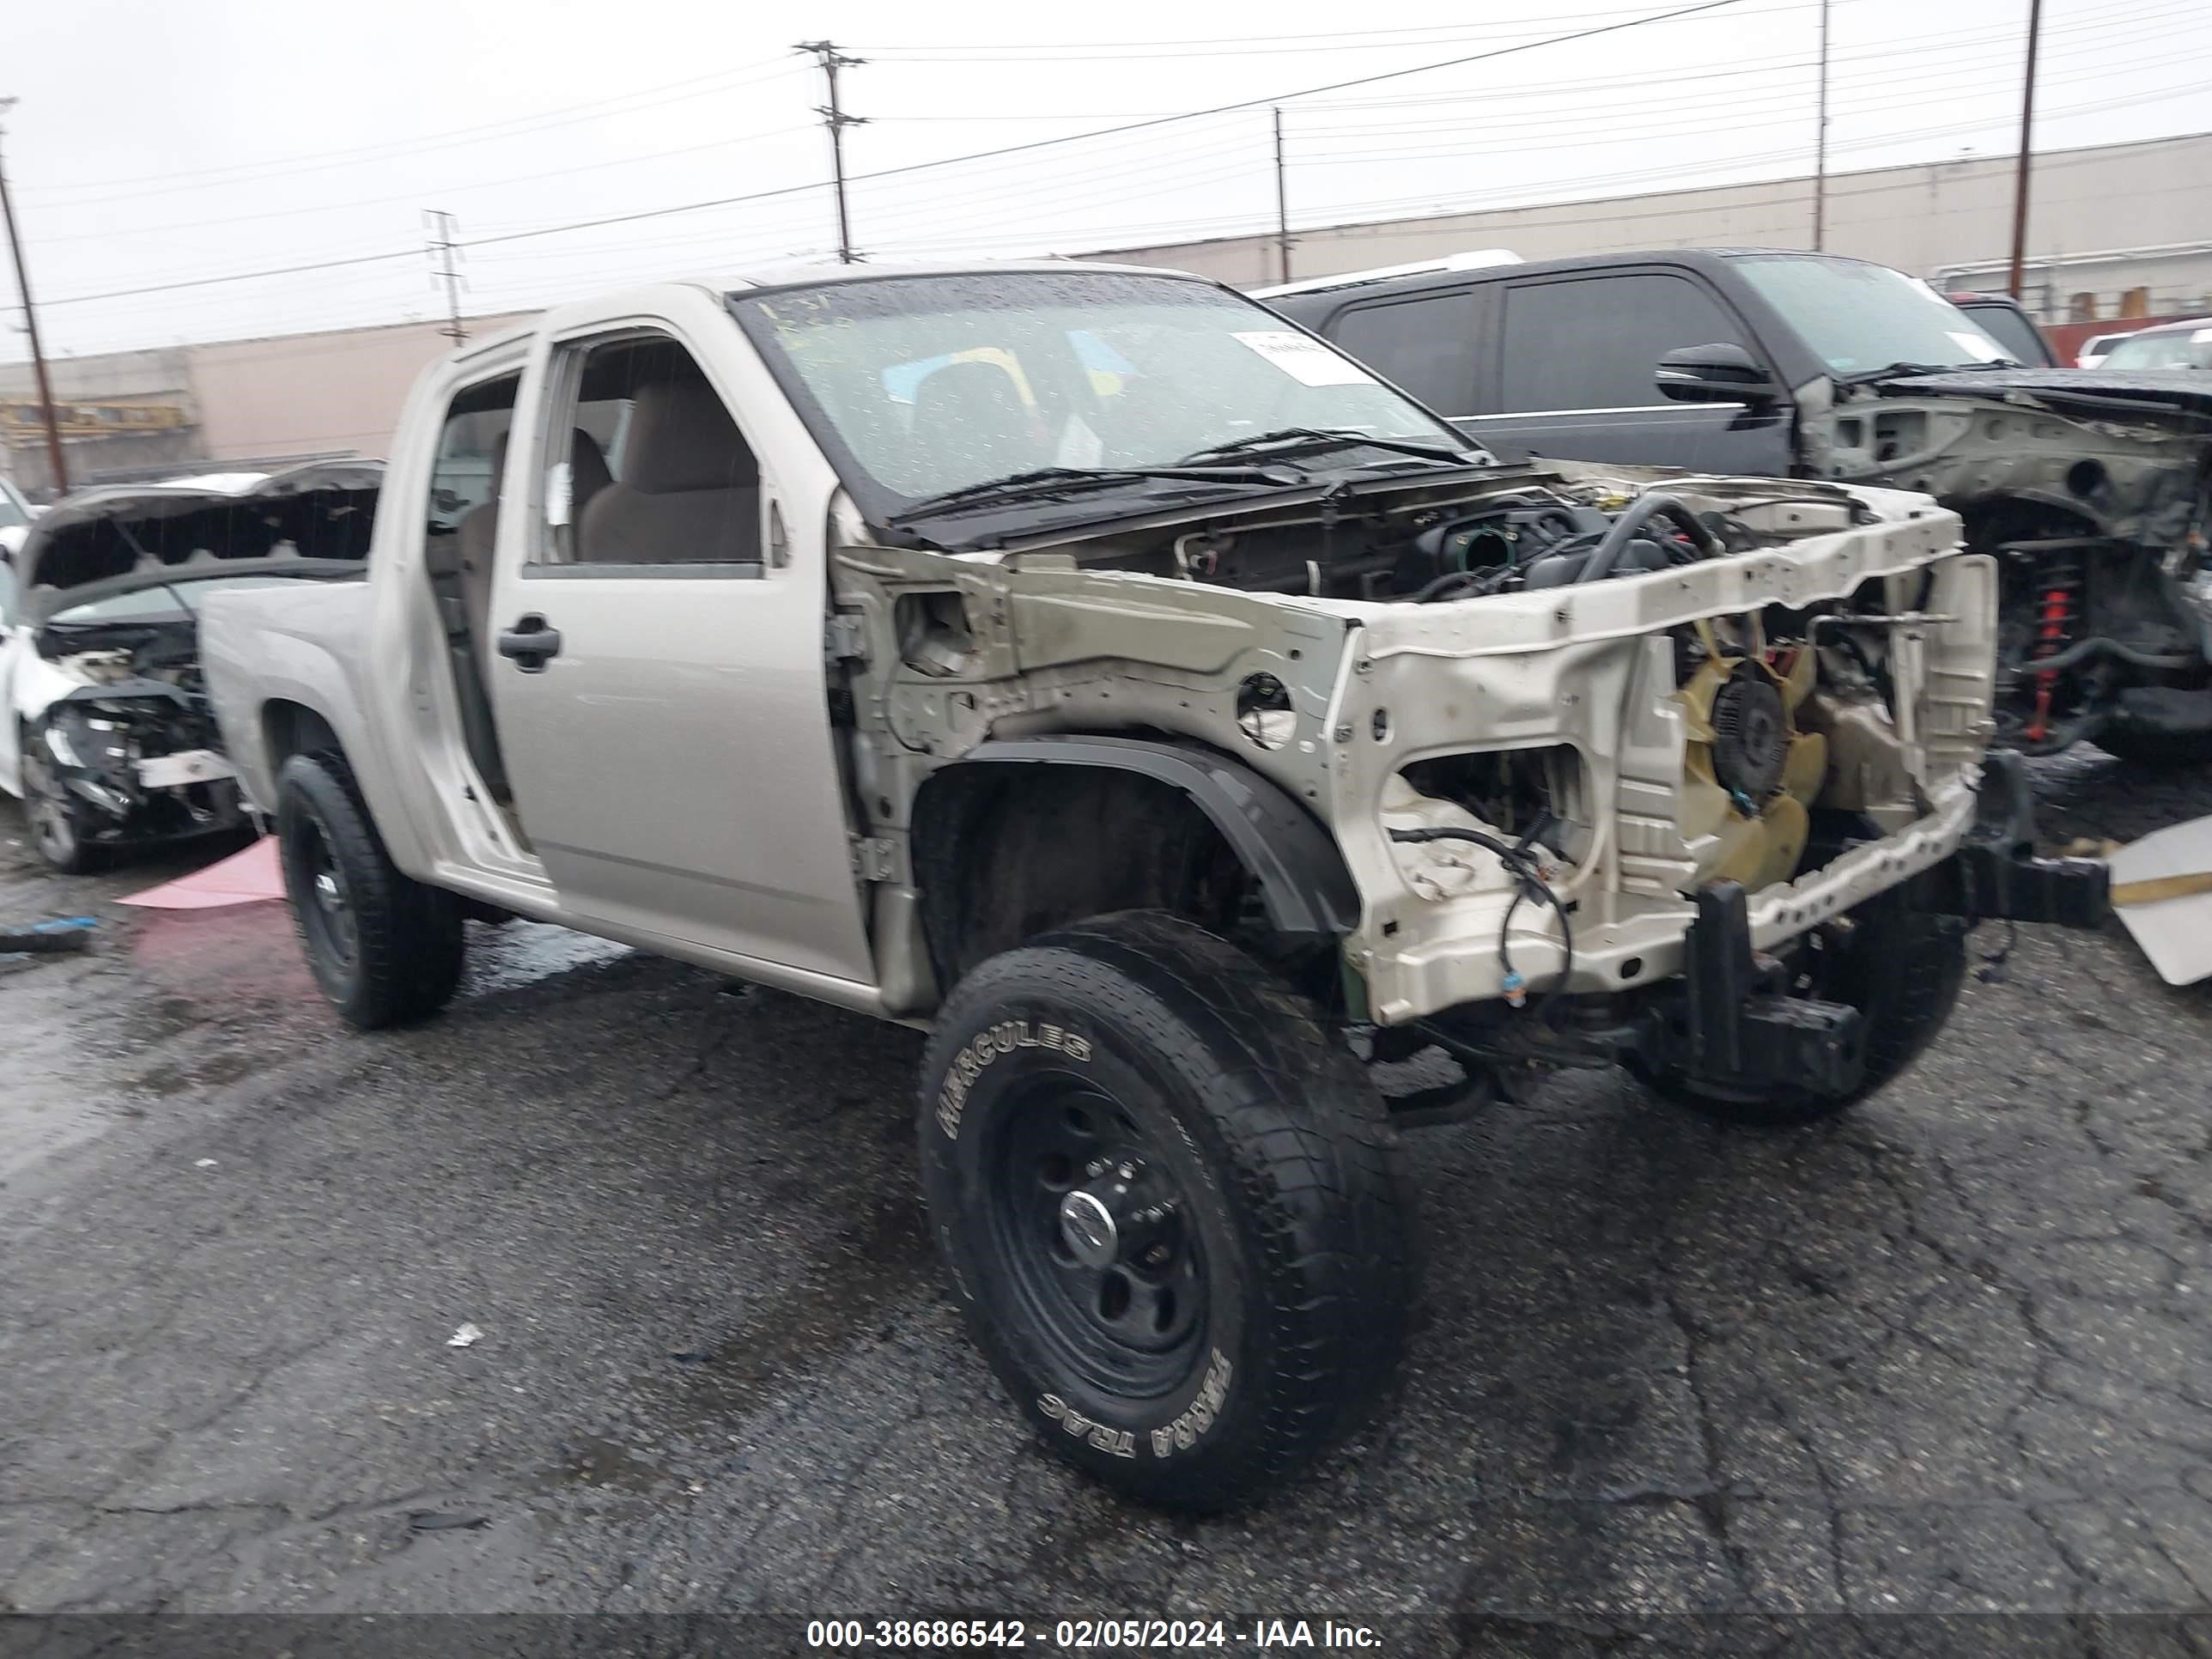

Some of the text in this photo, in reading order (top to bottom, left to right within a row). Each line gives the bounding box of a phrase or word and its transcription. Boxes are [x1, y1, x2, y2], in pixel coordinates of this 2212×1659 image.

[934, 1020, 1093, 1140] HERCULES
[1036, 1346, 1233, 1459] TERRA TRAC
